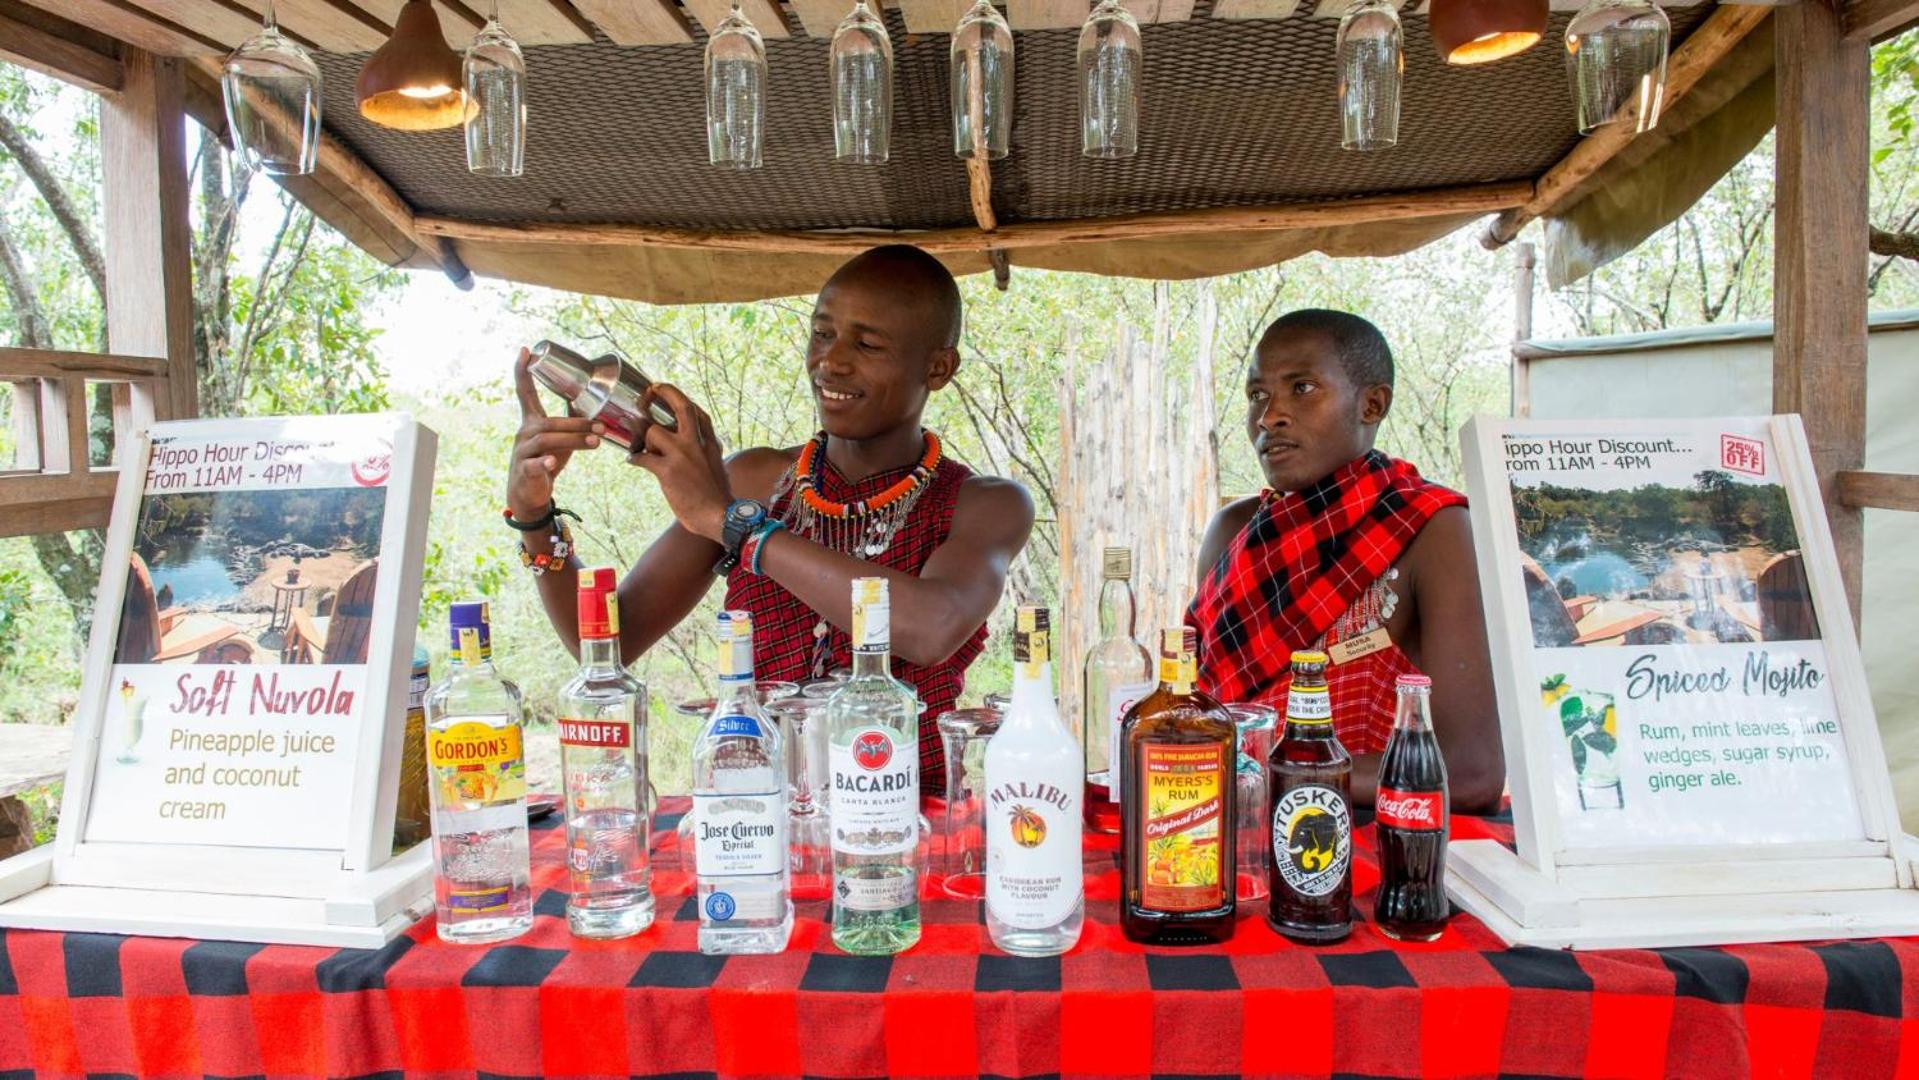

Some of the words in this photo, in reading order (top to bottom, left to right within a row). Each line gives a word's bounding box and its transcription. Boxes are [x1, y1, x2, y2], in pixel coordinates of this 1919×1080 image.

[149, 446, 198, 470] Hippo
[204, 443, 249, 463] Hour
[1504, 440, 1544, 458] ippo
[1549, 439, 1592, 455] Hour
[1599, 438, 1693, 455] Discount...
[1726, 440, 1760, 460] 25%
[1505, 460, 1540, 471] rom
[1548, 456, 1595, 471] 11AM
[1613, 456, 1652, 470] 4PM
[1726, 454, 1760, 470] OFF
[144, 470, 187, 489] From
[193, 466, 242, 487] 11AM
[262, 464, 303, 484] 4PM
[1625, 654, 1731, 702] Spiced
[1743, 650, 1825, 698] Mojito
[169, 669, 237, 717] Soft
[249, 670, 355, 716] Nuvola
[560, 723, 622, 743] IRNOFF
[719, 719, 751, 732] Silver
[1639, 722, 1686, 742] Rum,
[1692, 721, 1731, 738] mint
[1736, 720, 1795, 738] leaves,
[169, 728, 275, 757] Pineapple
[280, 730, 336, 758] juice
[435, 737, 508, 760] GORDON'S
[1643, 749, 1716, 769] wedges,
[1722, 747, 1771, 764] sugar
[1776, 744, 1830, 763] syrup,
[164, 762, 206, 785] and
[212, 765, 302, 787] coconut
[836, 765, 911, 793] BACARDÍ
[1154, 775, 1214, 787] MYERS'S
[1649, 773, 1704, 792] ginger
[1710, 770, 1742, 787] ale.
[990, 781, 1073, 812] MALIBU
[1168, 790, 1199, 800] RUM
[159, 800, 226, 820] cream
[1147, 811, 1192, 835] Original
[1192, 799, 1219, 818] Dark
[1276, 790, 1348, 828] TUSKER
[700, 821, 729, 841] Jose
[731, 821, 774, 840] Cuervo
